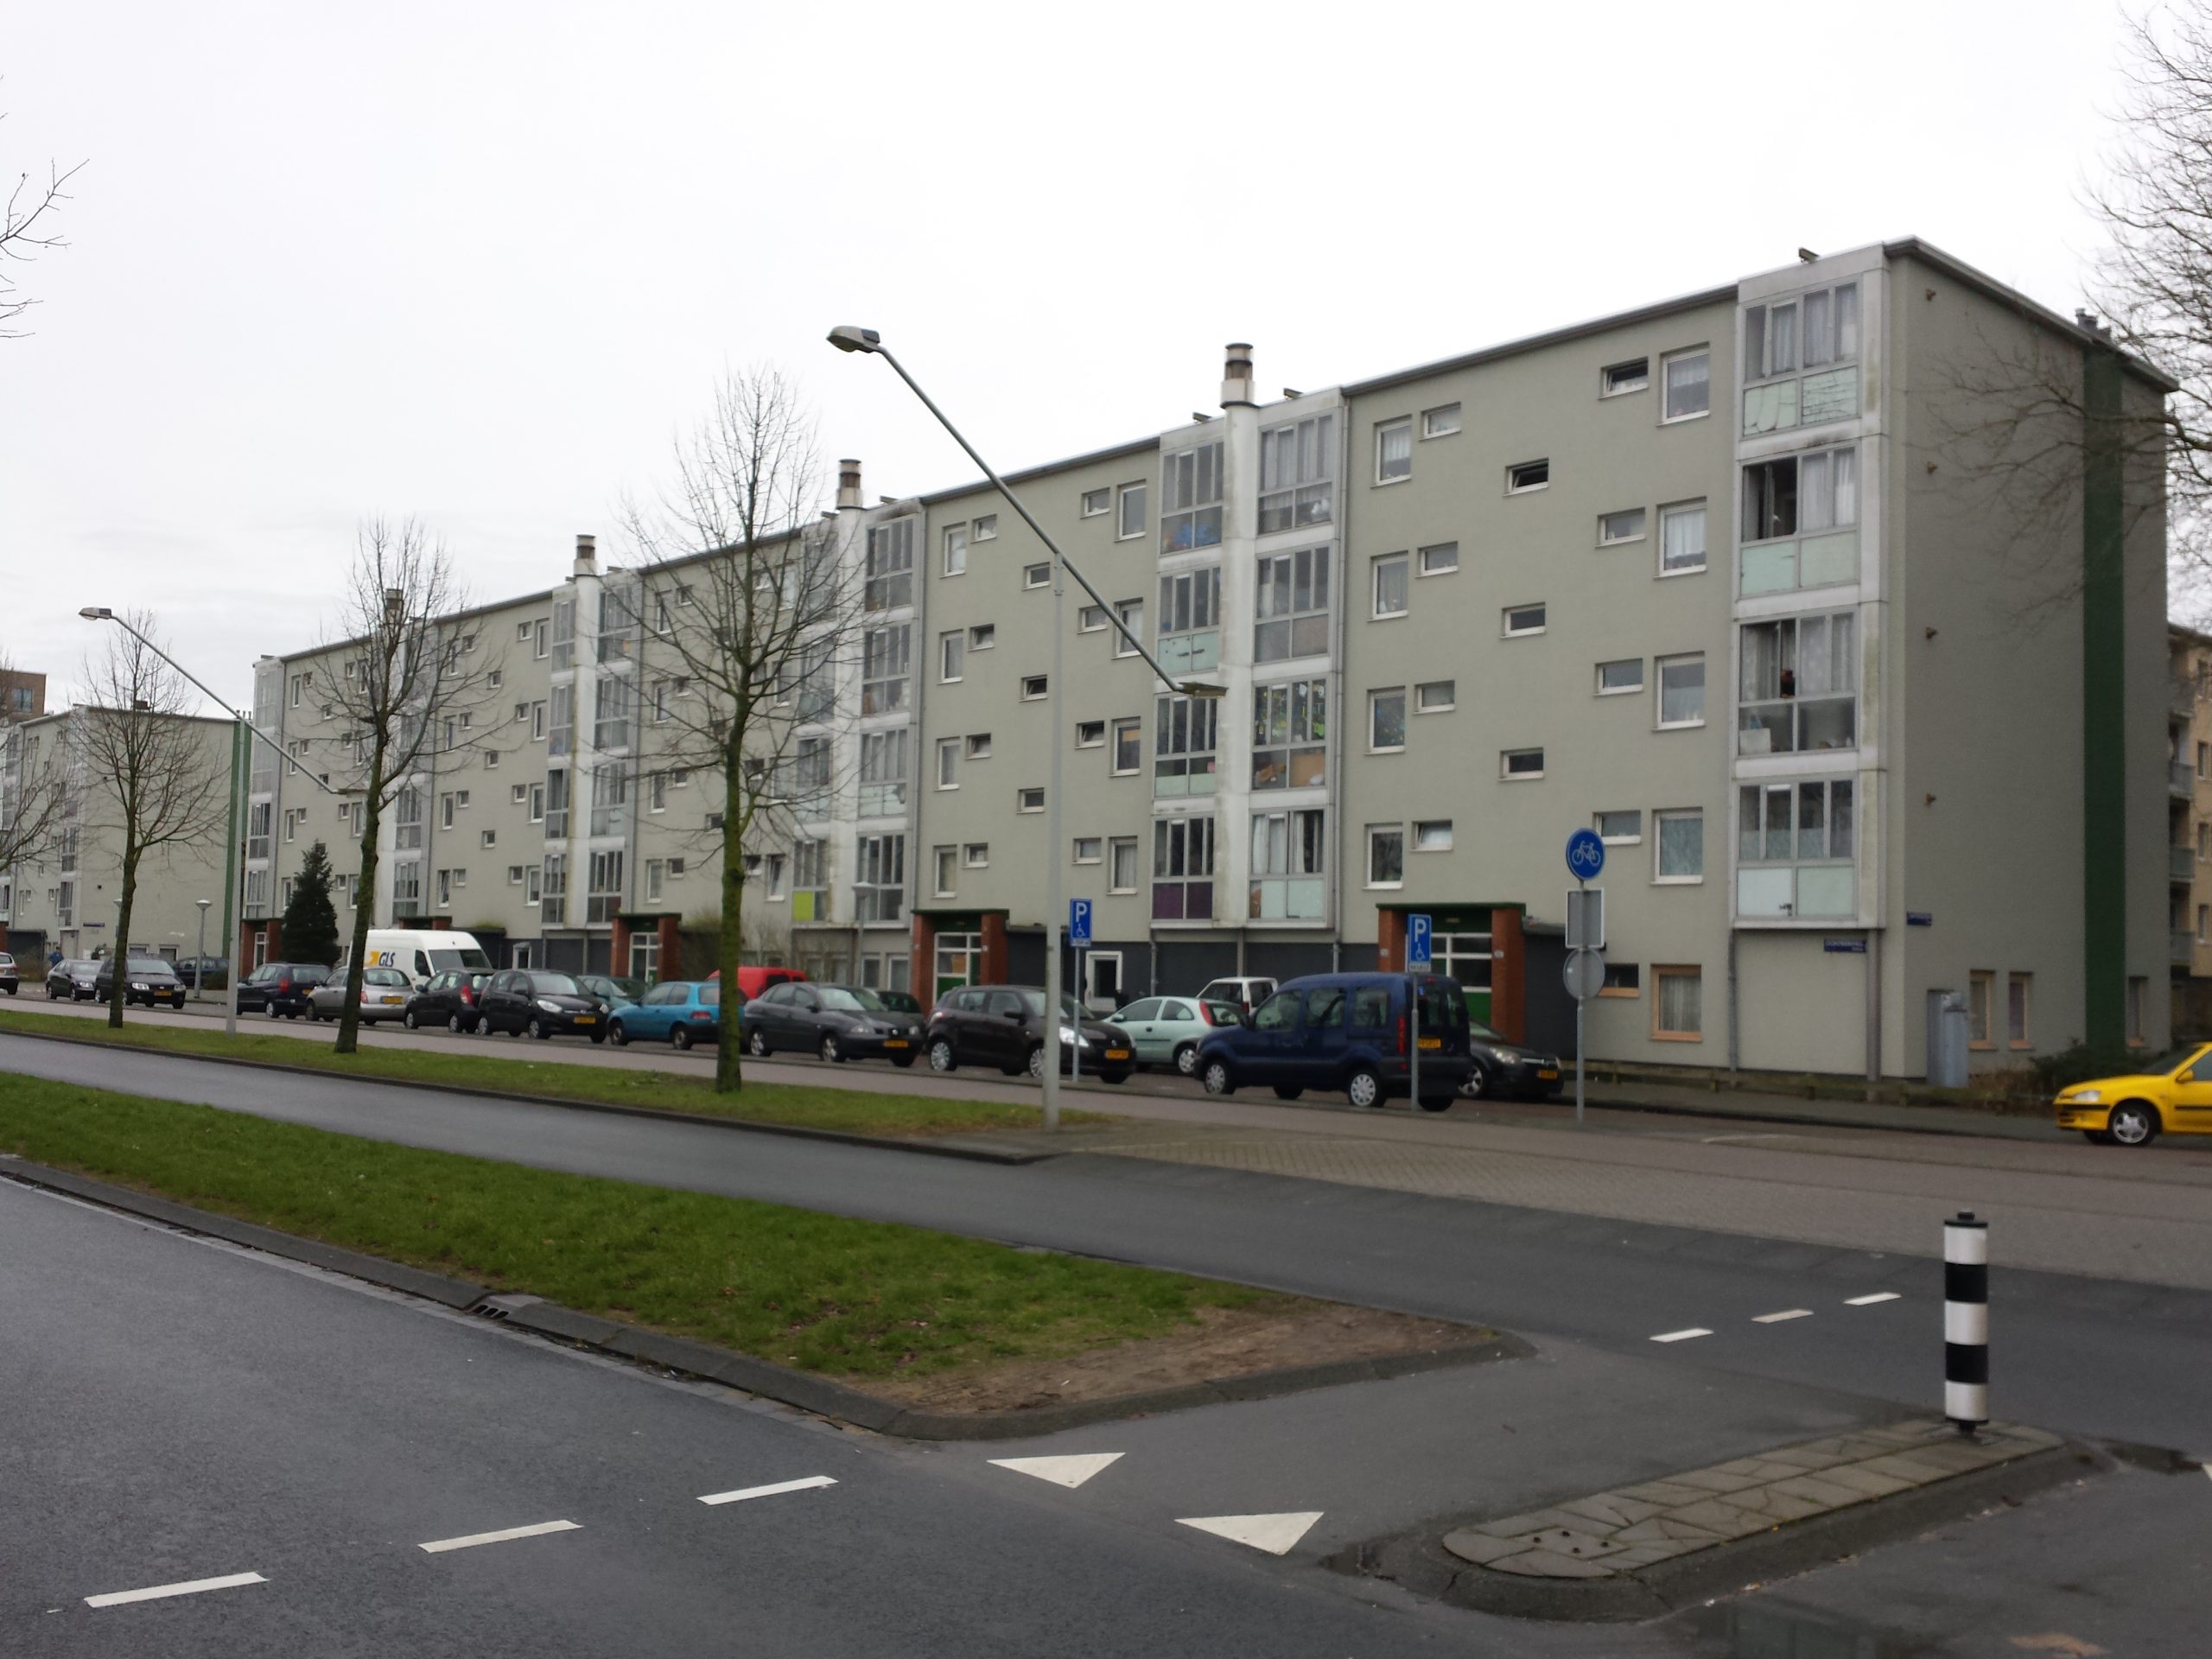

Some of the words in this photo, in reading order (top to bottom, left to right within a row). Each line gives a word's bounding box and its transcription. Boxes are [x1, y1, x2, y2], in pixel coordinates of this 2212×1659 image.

[1076, 902, 1087, 923] P
[1414, 918, 1427, 943] P
[378, 951, 396, 968] GLS
